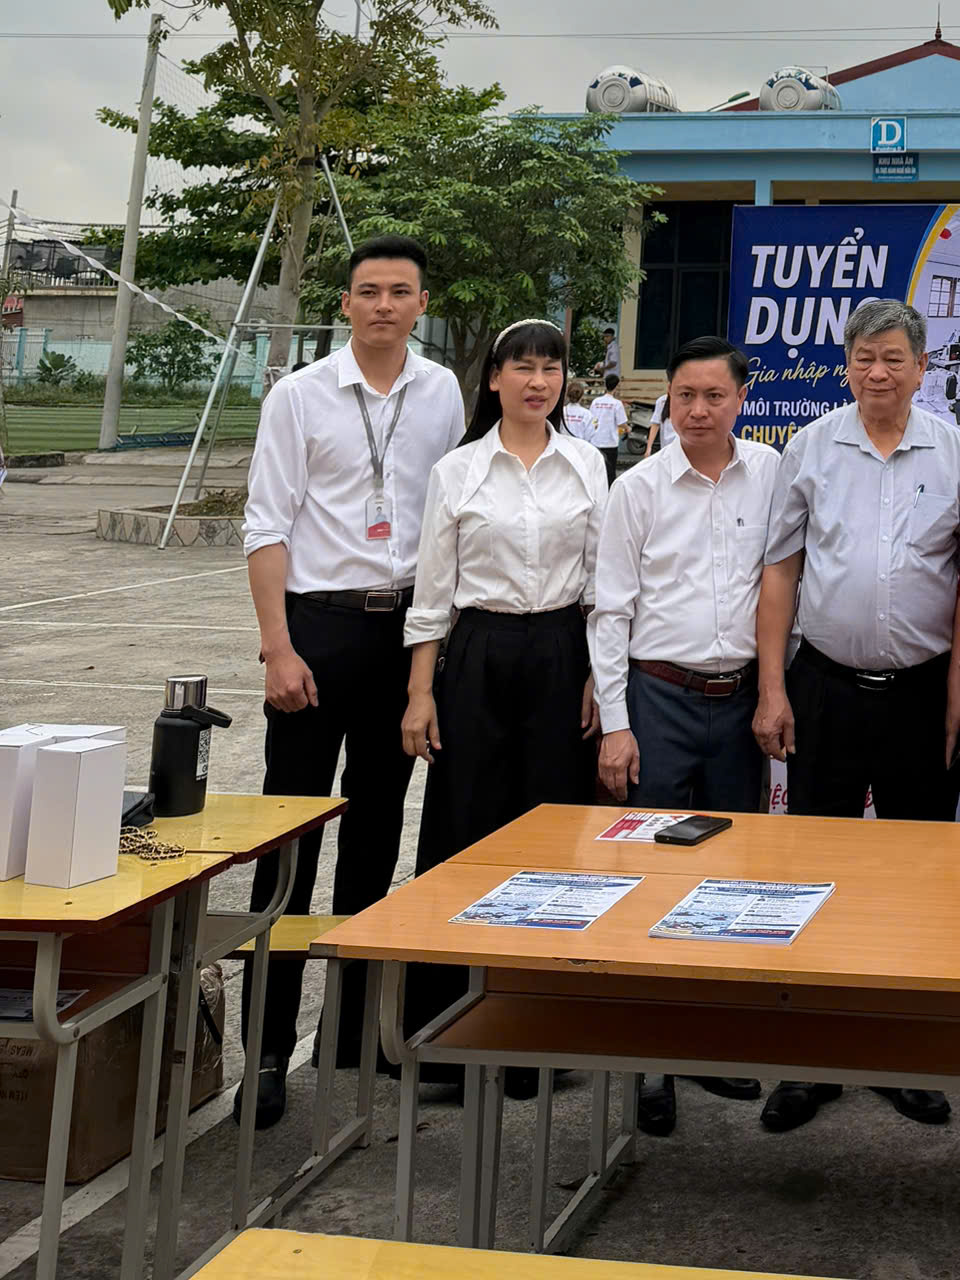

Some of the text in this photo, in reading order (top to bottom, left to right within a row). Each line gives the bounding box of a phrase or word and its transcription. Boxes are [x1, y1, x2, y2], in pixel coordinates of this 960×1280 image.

[878, 121, 902, 145] D
[751, 227, 889, 288] TUYỂN
[744, 297, 881, 359] DỤN
[745, 357, 779, 390] Gia
[781, 357, 830, 388] nhập
[743, 397, 770, 416] MÔI
[773, 397, 830, 417] TRƯỜNG
[741, 421, 803, 445] CHUYÊ
